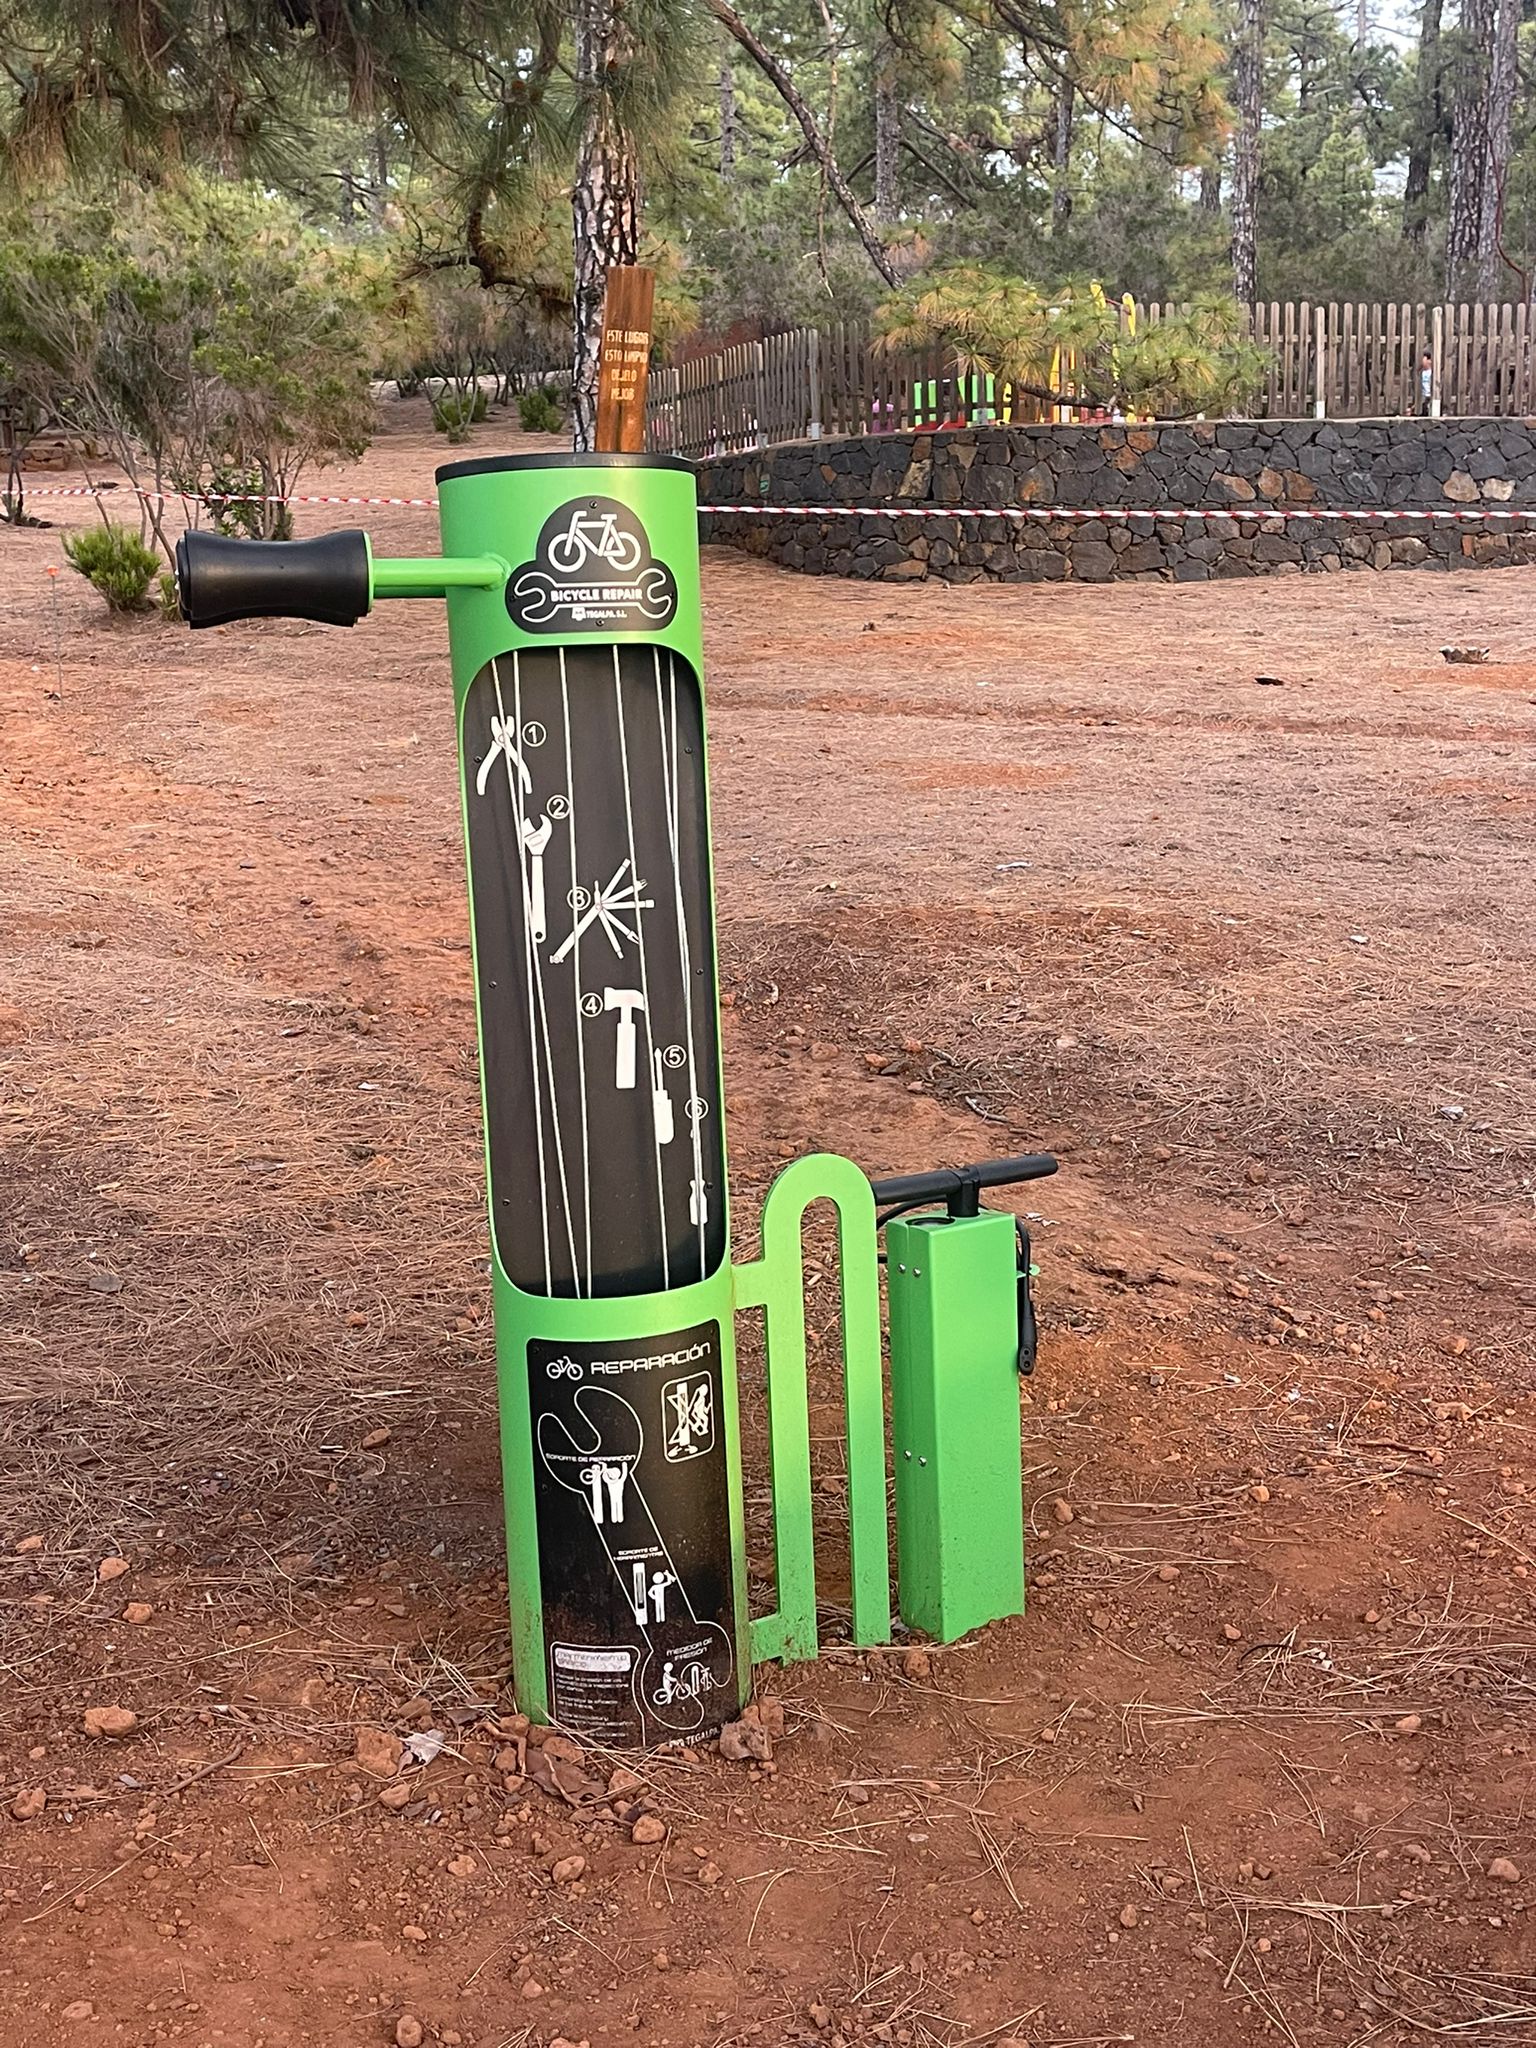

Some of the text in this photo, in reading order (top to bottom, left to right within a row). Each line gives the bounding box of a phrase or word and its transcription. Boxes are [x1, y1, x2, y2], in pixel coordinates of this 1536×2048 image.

[607, 329, 623, 343] ESTE
[550, 588, 643, 602] BICYCLE REPAIR
